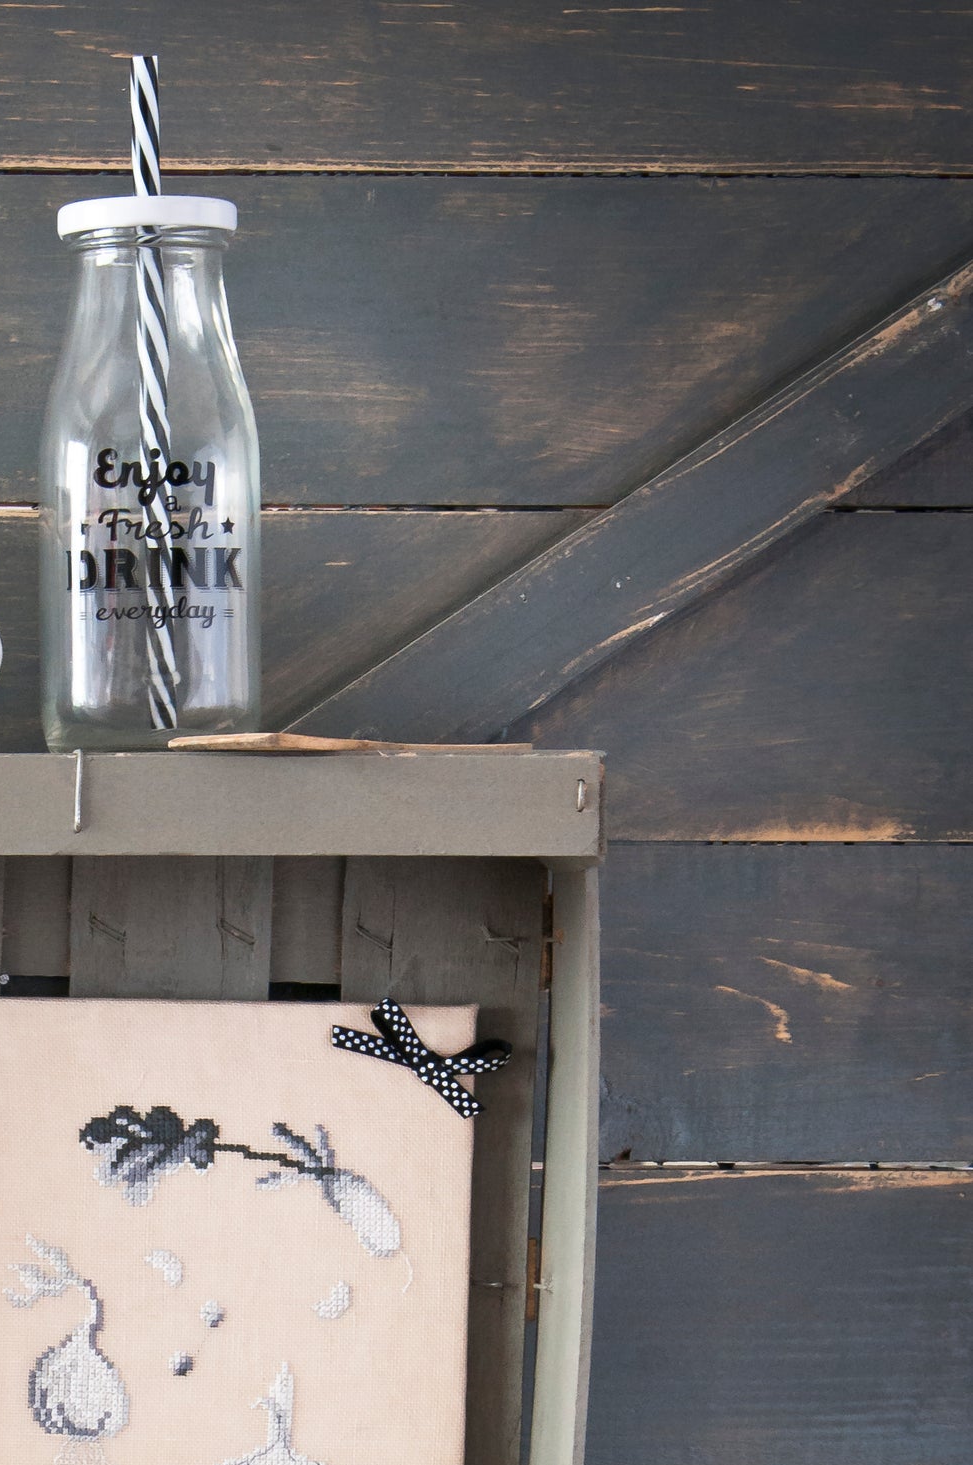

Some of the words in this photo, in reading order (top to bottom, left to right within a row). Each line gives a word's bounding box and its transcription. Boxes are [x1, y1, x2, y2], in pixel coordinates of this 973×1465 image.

[93, 447, 216, 506] Enjoy
[165, 495, 181, 512] a
[97, 506, 214, 542] Fresh
[65, 546, 246, 592] DRINK
[95, 596, 217, 629] everyday
